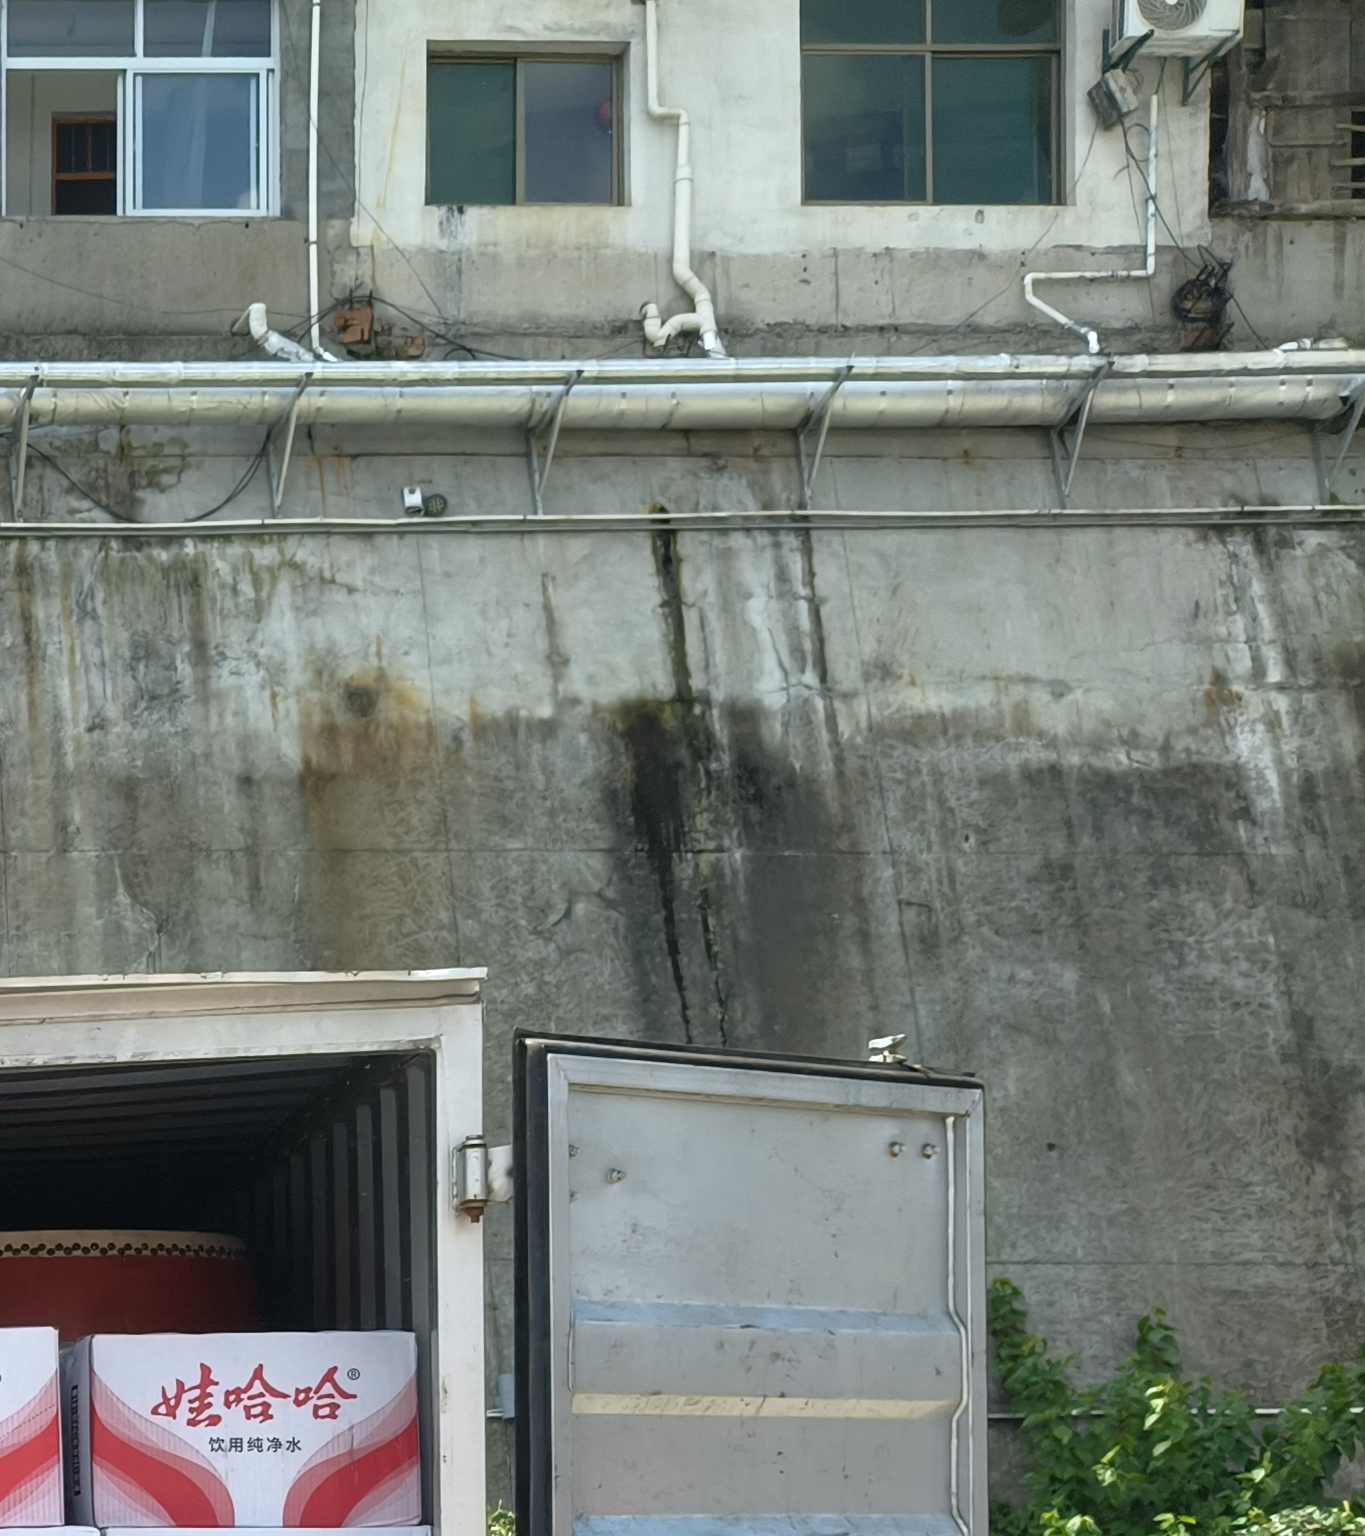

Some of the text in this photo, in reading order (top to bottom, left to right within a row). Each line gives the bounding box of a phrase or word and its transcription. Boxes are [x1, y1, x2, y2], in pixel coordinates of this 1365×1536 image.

[151, 1362, 357, 1427] 娃哈哈
[208, 1437, 302, 1453] 饮用纯净水
